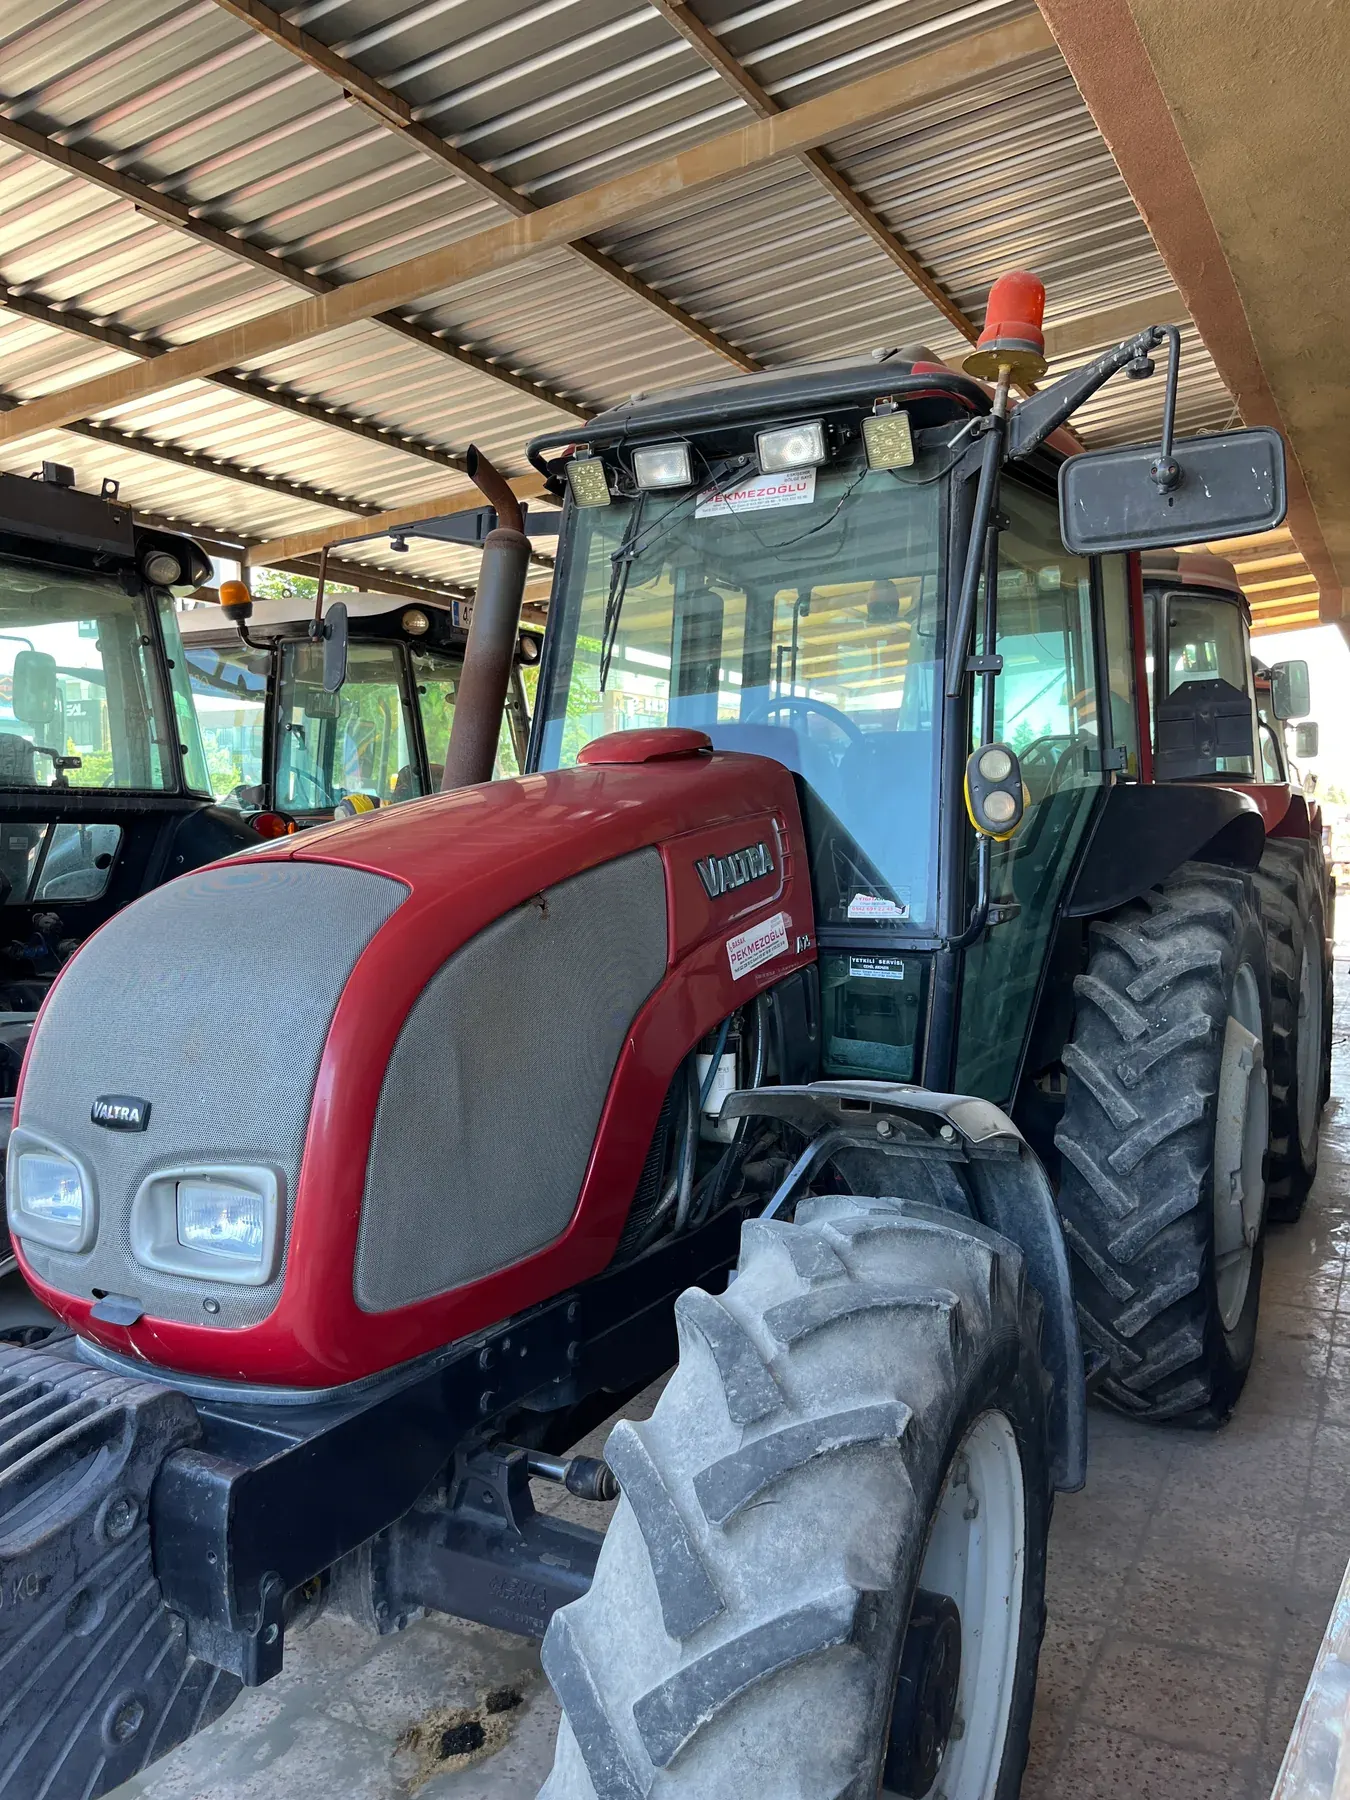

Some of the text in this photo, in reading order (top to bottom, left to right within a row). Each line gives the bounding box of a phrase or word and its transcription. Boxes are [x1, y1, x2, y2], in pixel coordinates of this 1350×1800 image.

[695, 842, 775, 899] VALTRA
[730, 927, 785, 965] PEKMEZOĞLU
[94, 1101, 140, 1122] VALTRA
